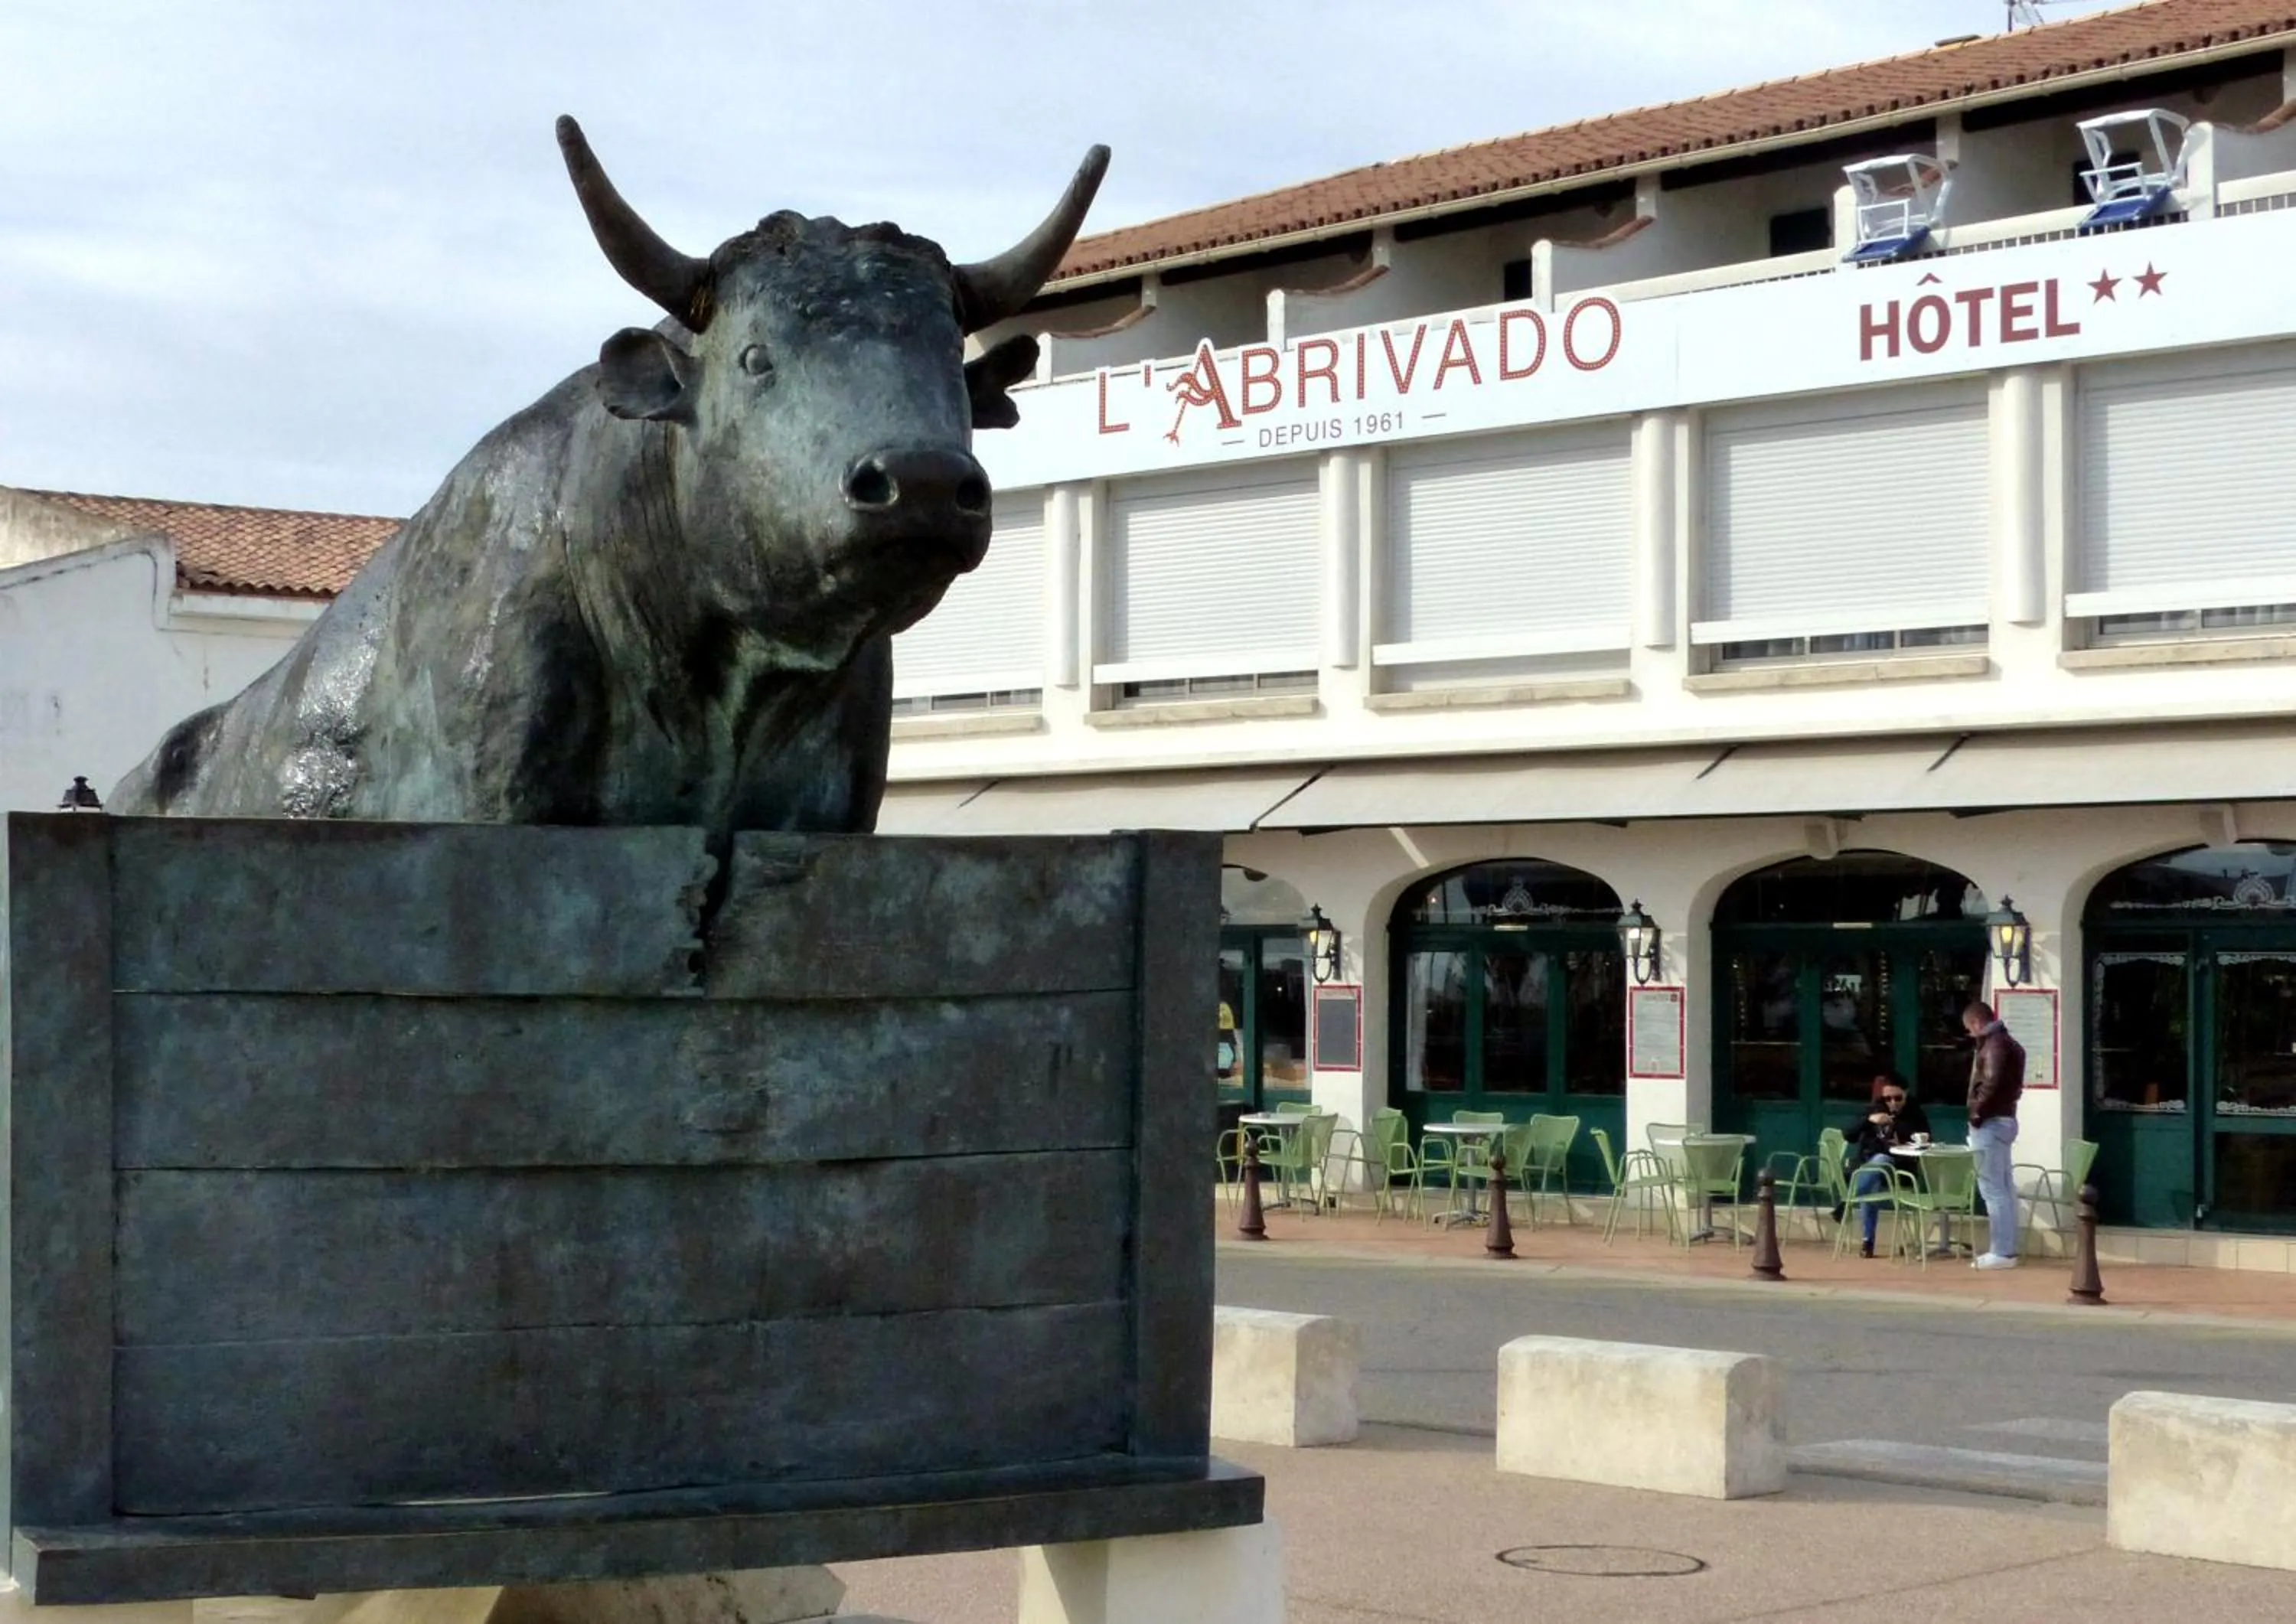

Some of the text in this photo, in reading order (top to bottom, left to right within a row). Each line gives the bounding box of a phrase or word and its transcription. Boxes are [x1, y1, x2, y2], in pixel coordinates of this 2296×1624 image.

[1860, 272, 2080, 361] HÔTEL
[1098, 296, 1621, 445] L'ABRIVADO
[1259, 411, 1404, 448] DEPUIS 1961
